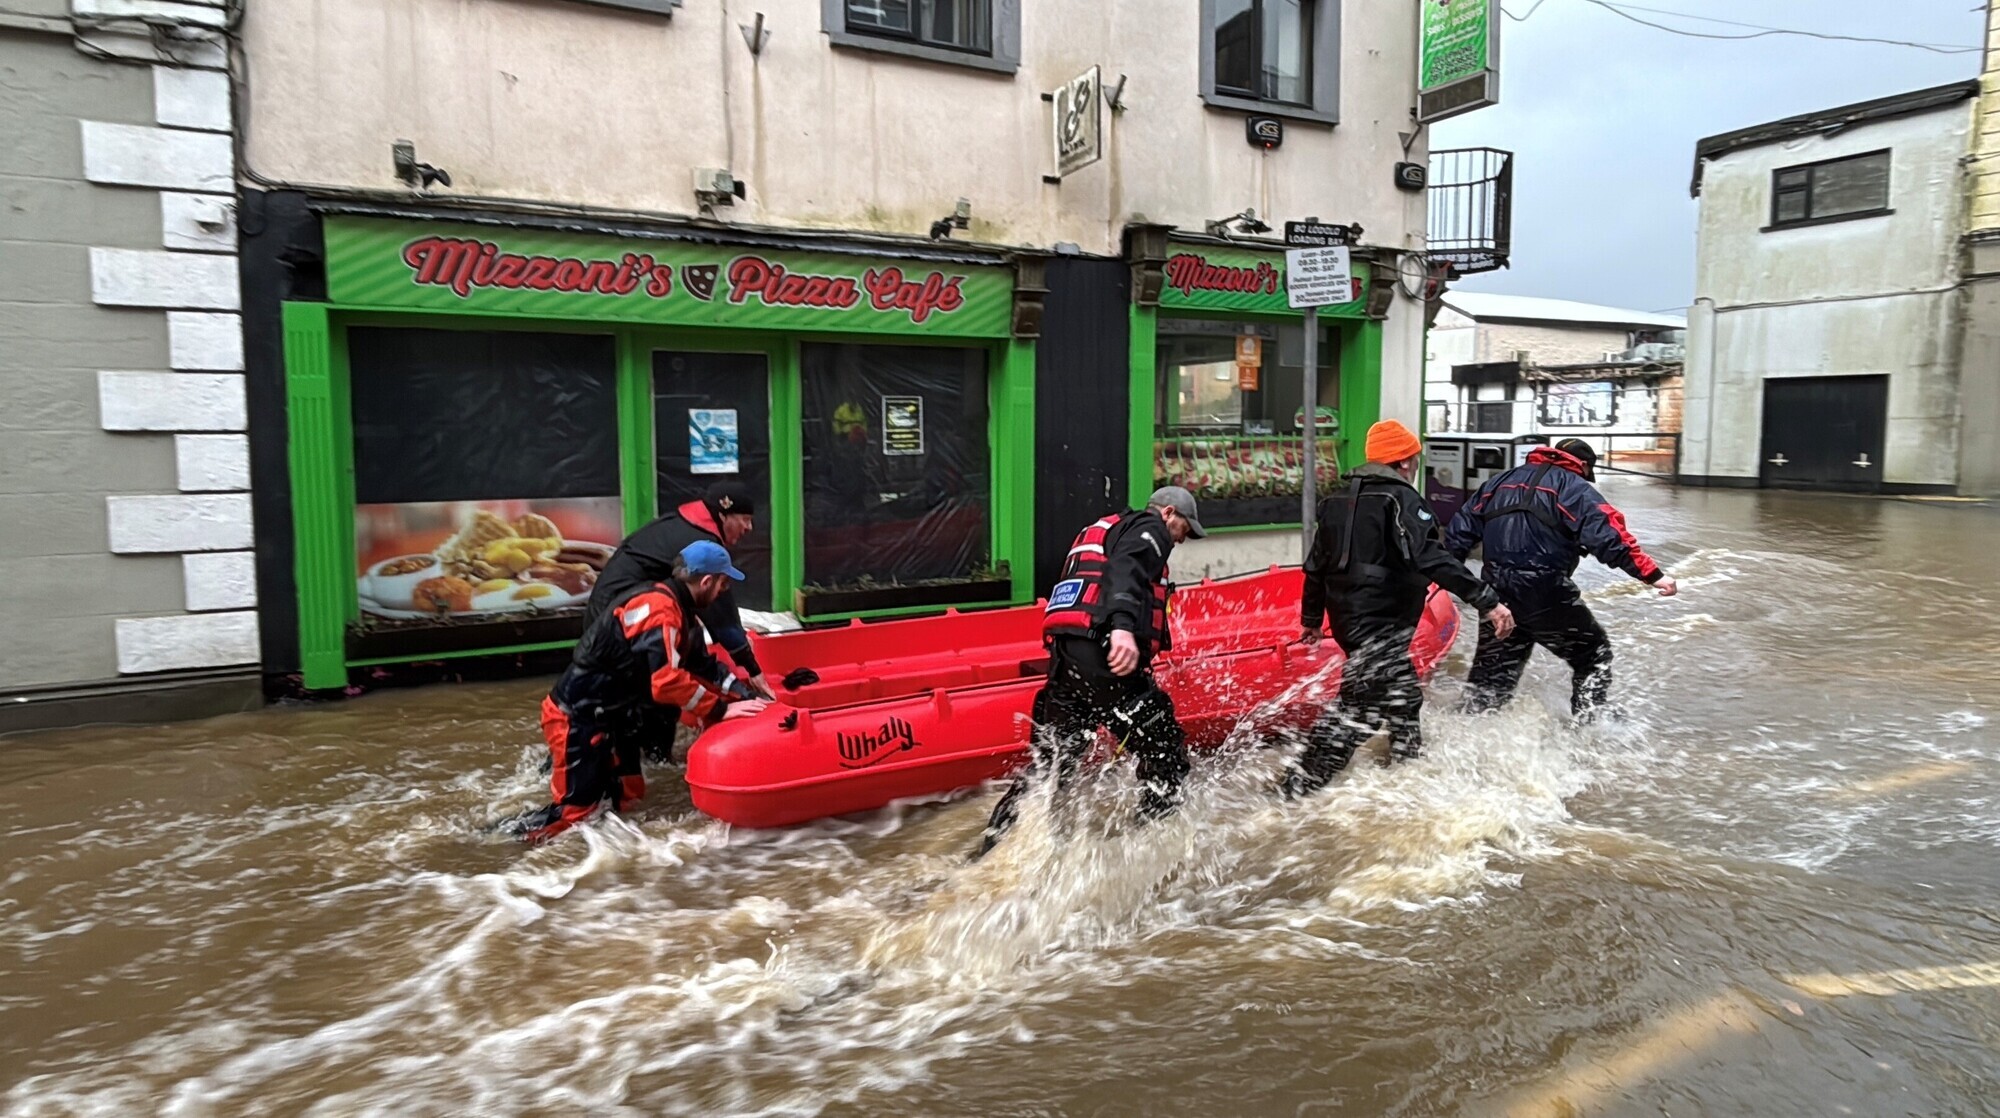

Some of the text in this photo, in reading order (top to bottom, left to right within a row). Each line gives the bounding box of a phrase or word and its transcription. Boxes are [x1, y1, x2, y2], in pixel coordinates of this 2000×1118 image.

[1288, 234, 1345, 246] LOADING BAY
[403, 236, 967, 324] Mizzoni's Pizza Café
[1166, 253, 1279, 298] Mizzoni's
[1335, 279, 1350, 287] ONLY
[836, 715, 922, 762] Whally
